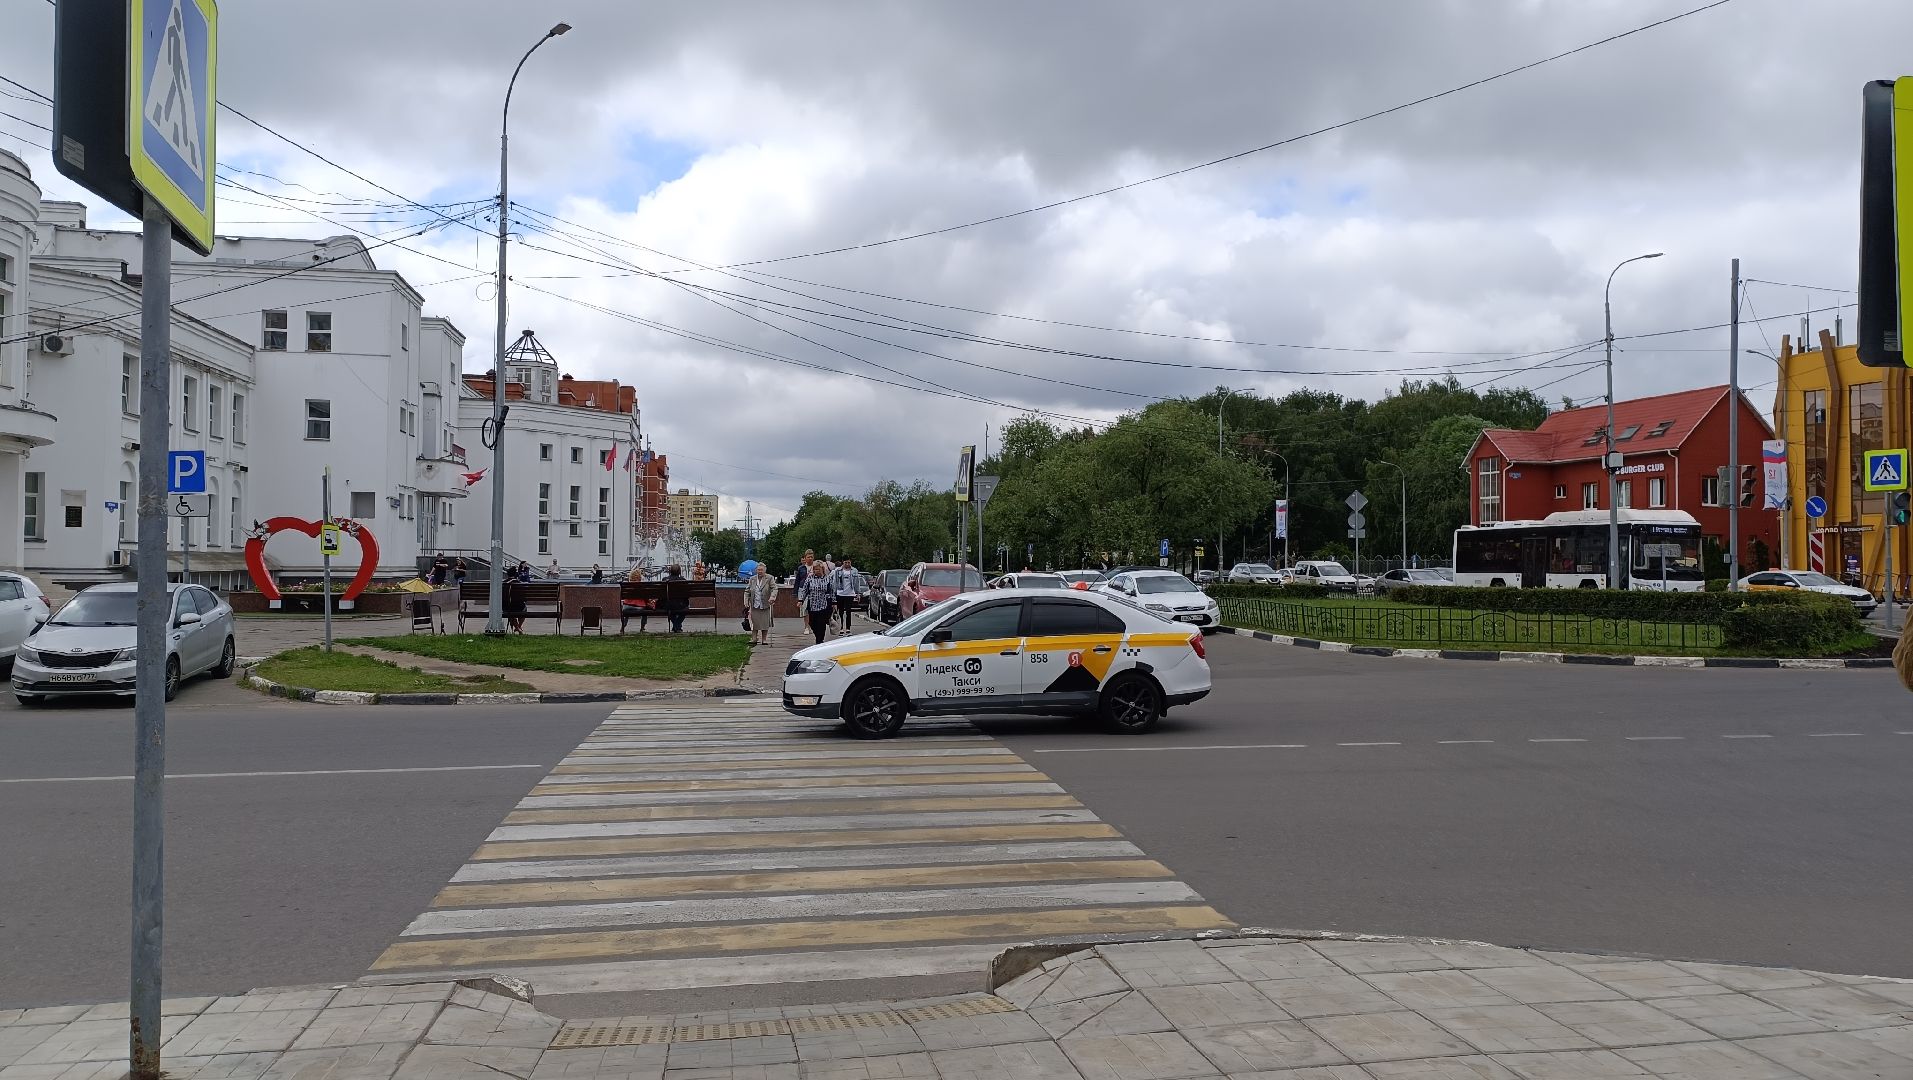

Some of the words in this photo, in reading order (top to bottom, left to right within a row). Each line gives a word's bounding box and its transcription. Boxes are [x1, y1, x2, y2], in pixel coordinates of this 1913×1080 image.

[174, 455, 198, 488] P
[1620, 465, 1646, 474] BURGER
[1647, 463, 1665, 472] CLUB
[1030, 653, 1048, 663] 858
[1071, 653, 1079, 665] Я
[925, 664, 963, 675] Яндекс
[966, 660, 981, 672] Go
[952, 676, 981, 687] Такси
